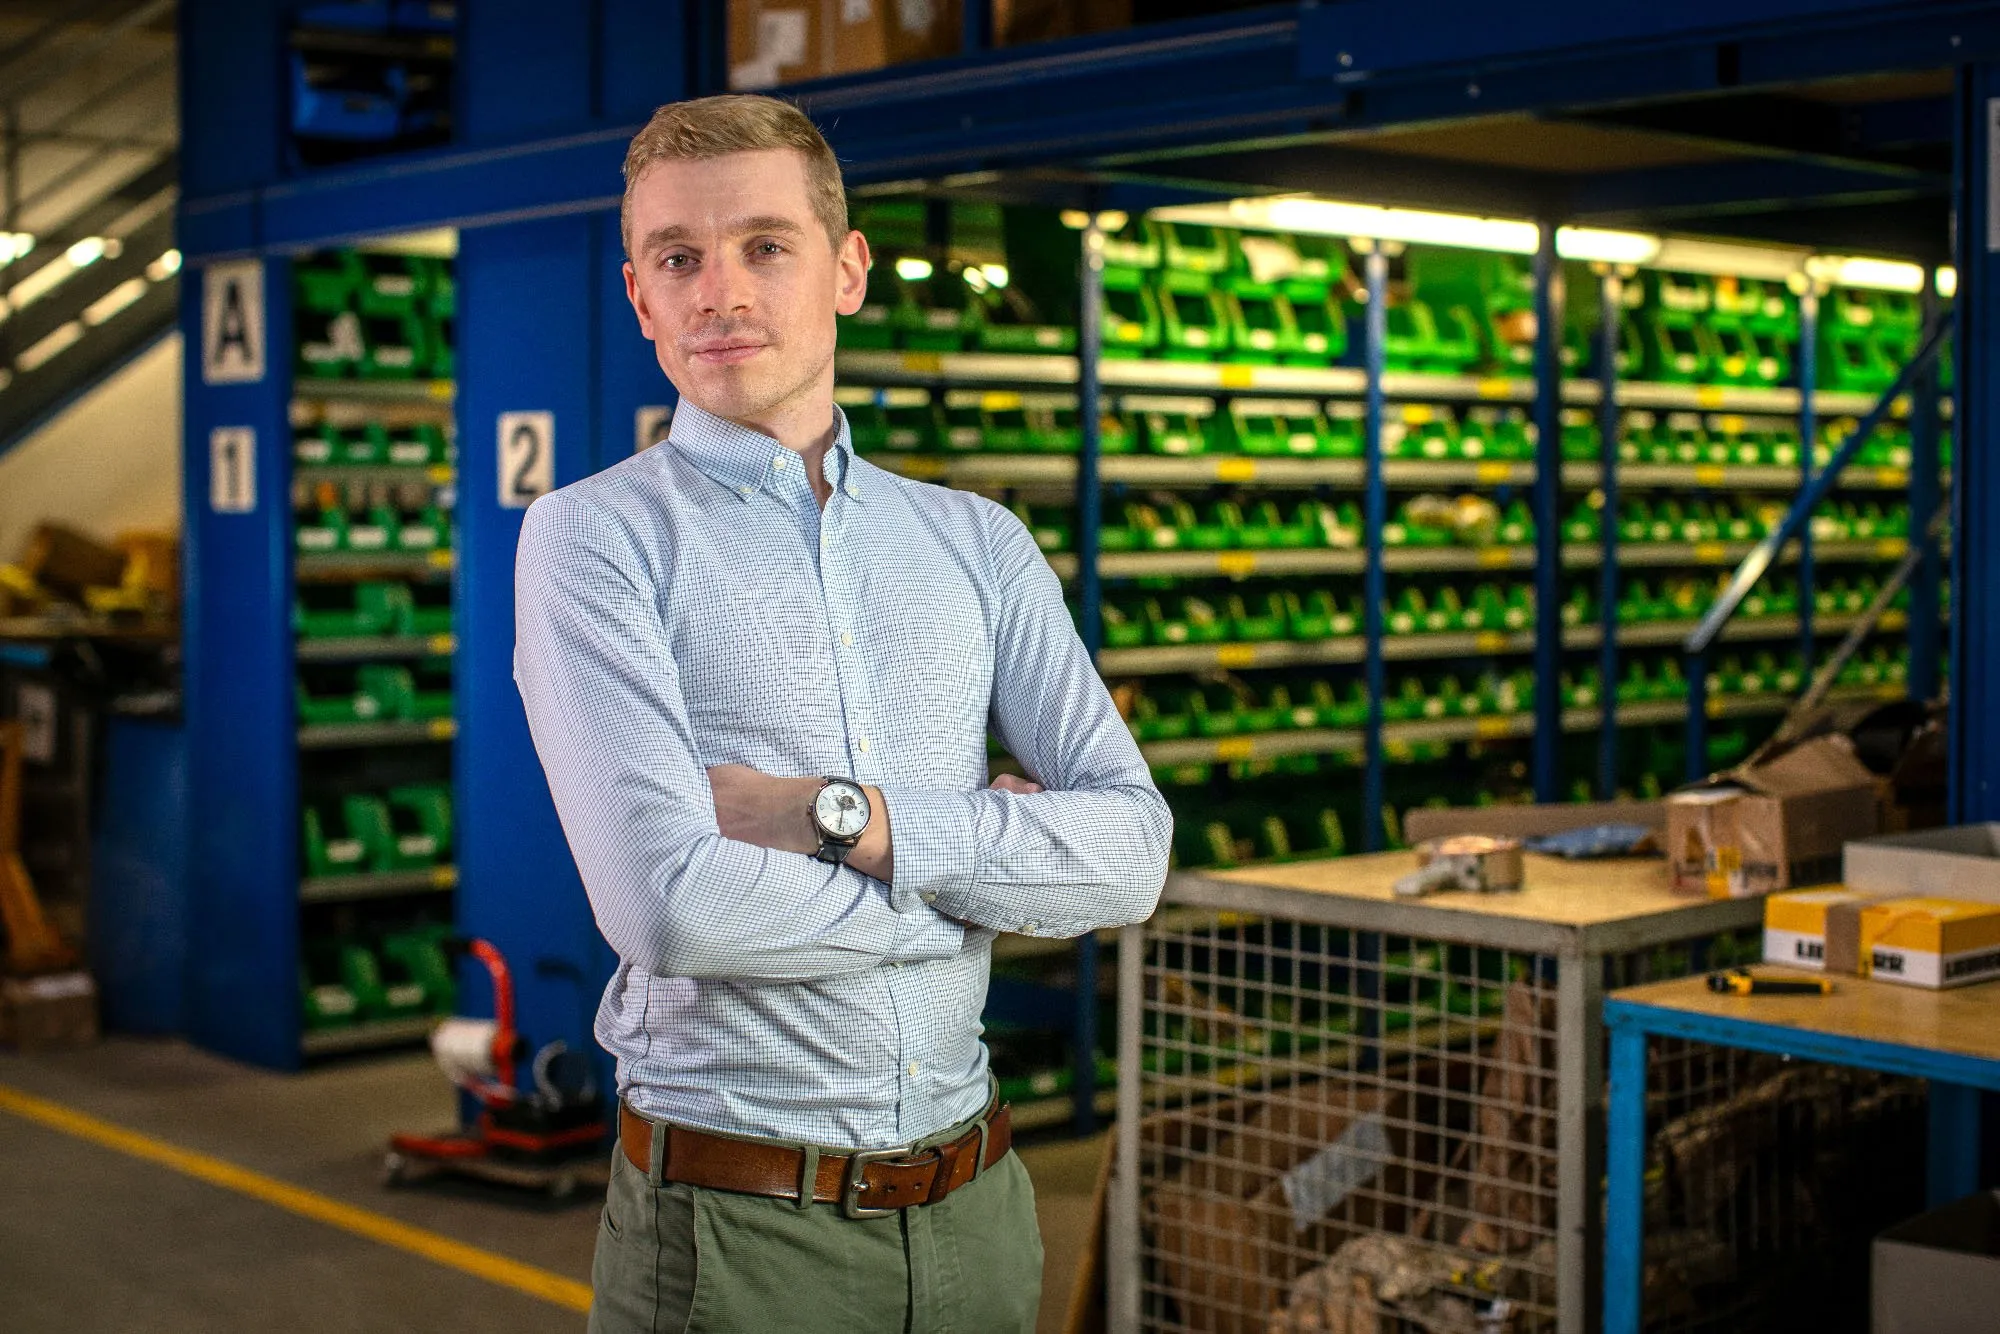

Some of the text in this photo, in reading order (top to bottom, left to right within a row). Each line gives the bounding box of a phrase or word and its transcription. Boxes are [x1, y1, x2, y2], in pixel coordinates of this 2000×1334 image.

[213, 276, 253, 364] A
[223, 440, 241, 500] 1
[509, 423, 540, 494] 2
